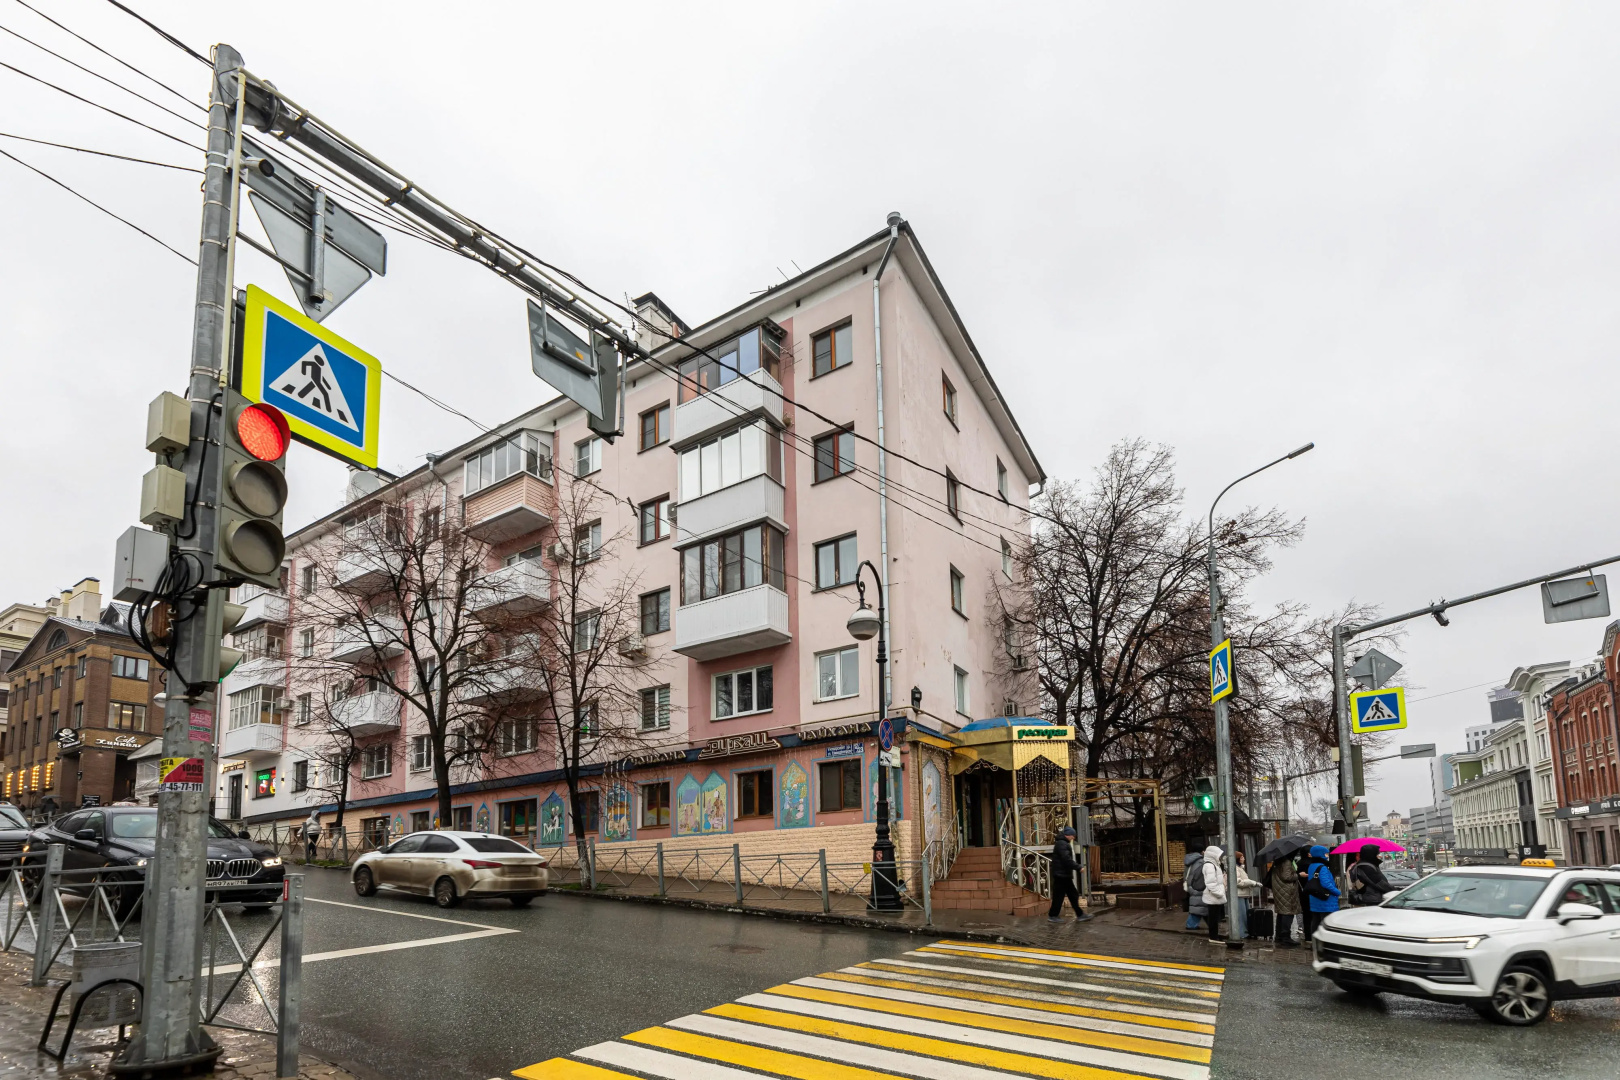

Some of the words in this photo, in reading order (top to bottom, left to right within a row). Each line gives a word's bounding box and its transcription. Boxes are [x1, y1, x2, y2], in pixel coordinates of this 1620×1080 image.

[797, 722, 872, 740] ЧАЙХАНА
[1017, 729, 1068, 739] ресторан
[182, 764, 203, 772] 1000
